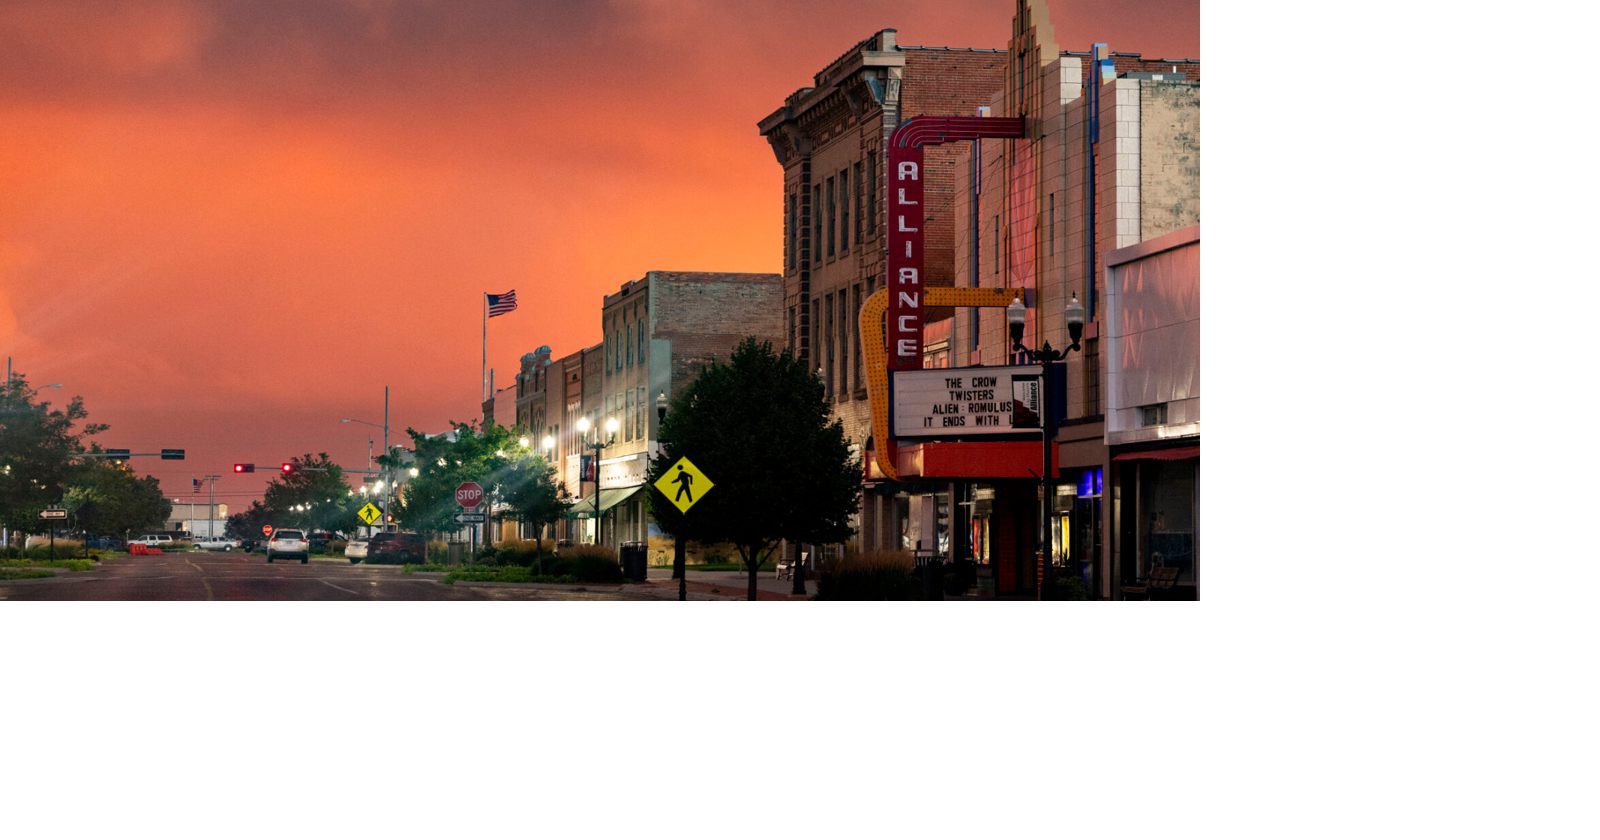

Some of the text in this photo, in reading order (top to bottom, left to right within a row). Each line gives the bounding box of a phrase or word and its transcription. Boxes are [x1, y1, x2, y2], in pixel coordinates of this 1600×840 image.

[898, 161, 918, 357] ALLIANCE
[945, 377, 997, 389] THE CROW
[949, 390, 994, 400] TWISTERS
[1030, 382, 1038, 411] Alliance
[932, 403, 959, 414] ALIEN
[968, 402, 1012, 413] ROMULUS
[924, 417, 933, 427] IT
[943, 416, 965, 427] ENDS
[975, 415, 999, 426] WITH
[458, 490, 482, 500] STOP
